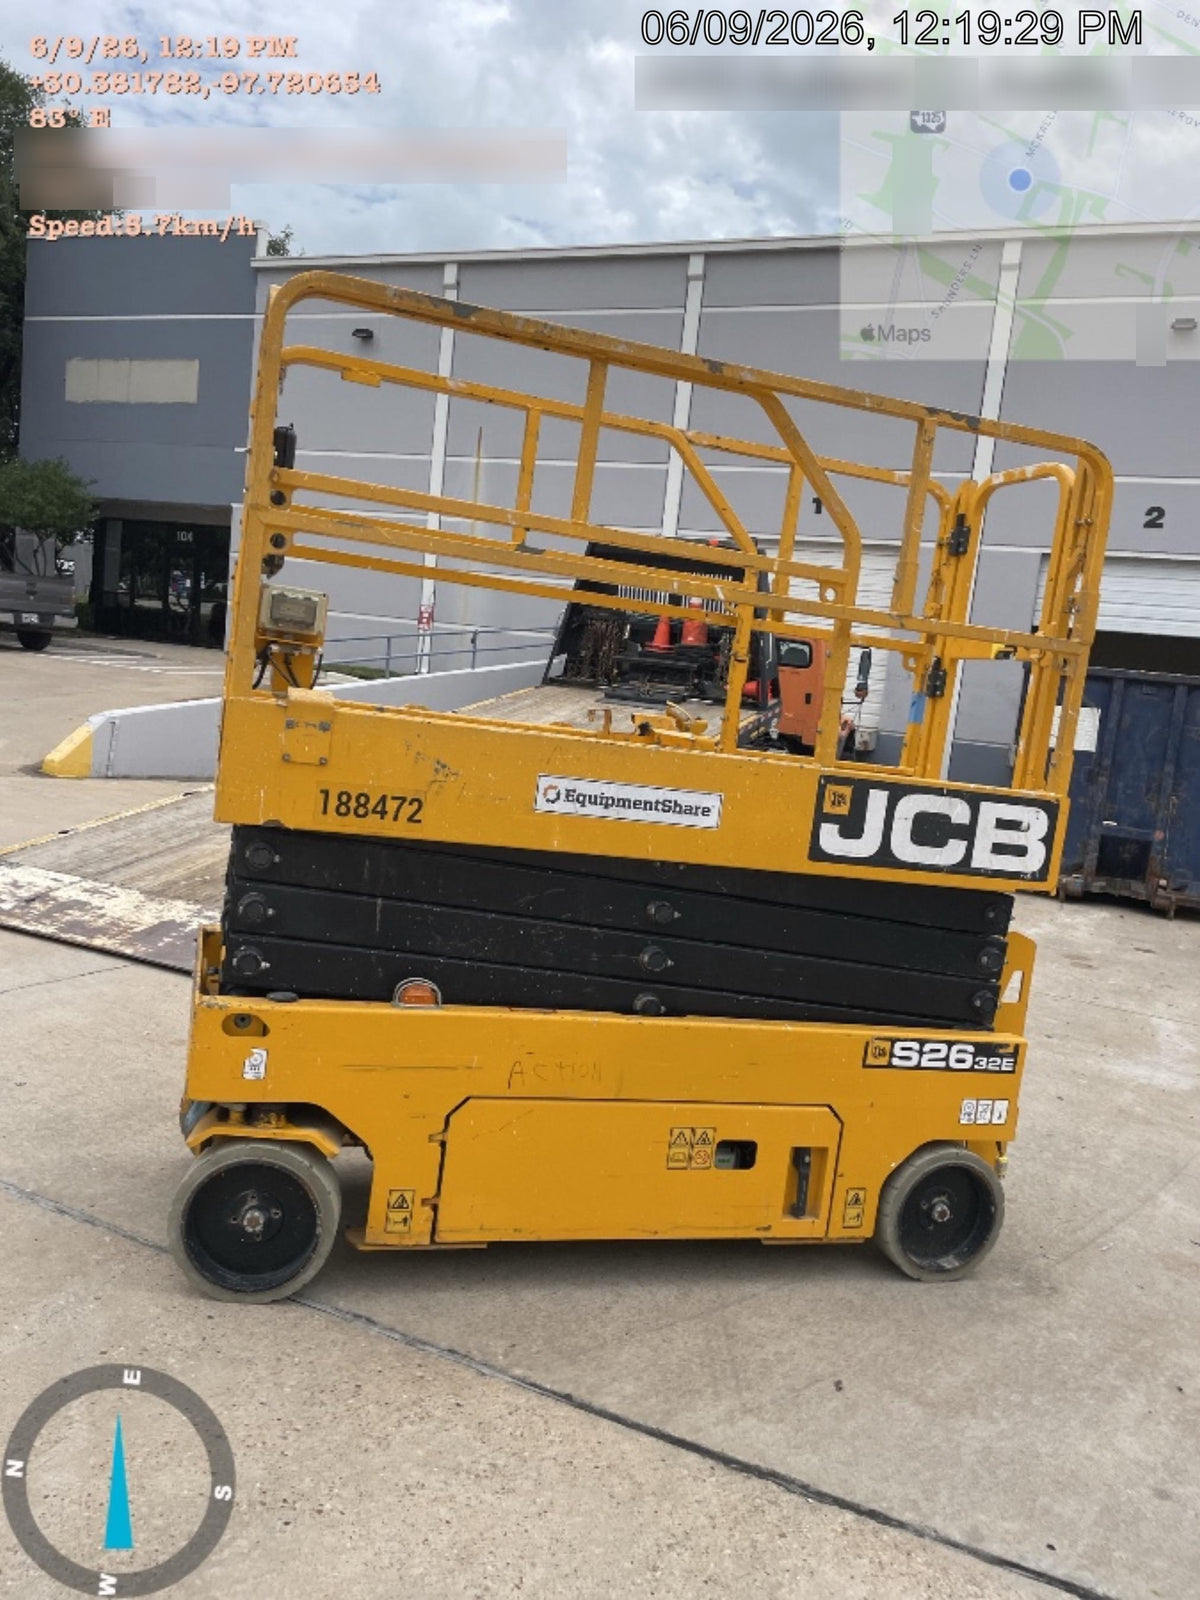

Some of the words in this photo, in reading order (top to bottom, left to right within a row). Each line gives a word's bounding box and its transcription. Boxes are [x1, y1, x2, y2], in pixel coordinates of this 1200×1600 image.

[812, 497, 823, 514] 1
[1143, 506, 1165, 528] 2
[319, 788, 424, 824] 188472
[563, 788, 711, 817] EquipmentShare
[818, 788, 1049, 874] JCB
[890, 1040, 976, 1070] S26
